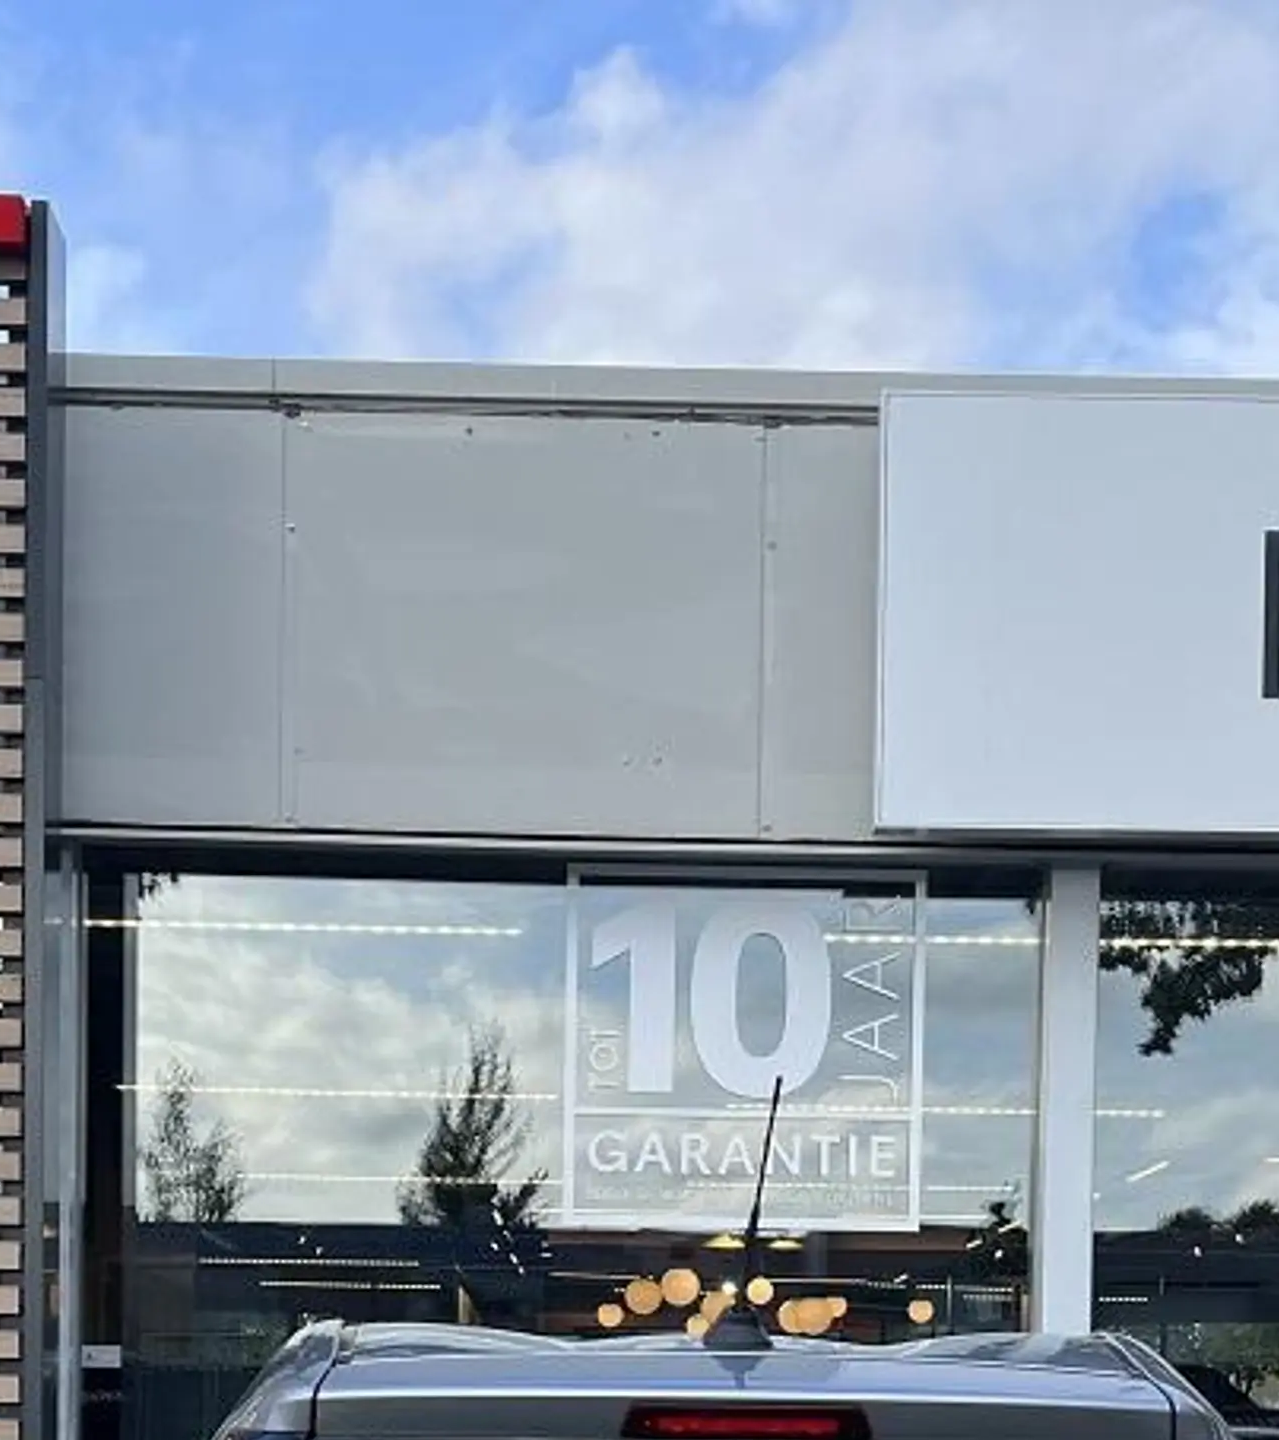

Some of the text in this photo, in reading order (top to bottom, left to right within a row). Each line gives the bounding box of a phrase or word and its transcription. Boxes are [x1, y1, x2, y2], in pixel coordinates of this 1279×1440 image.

[588, 902, 832, 1099] 10
[838, 895, 903, 1104] JAAR
[587, 1129, 897, 1178] GARANTIE
